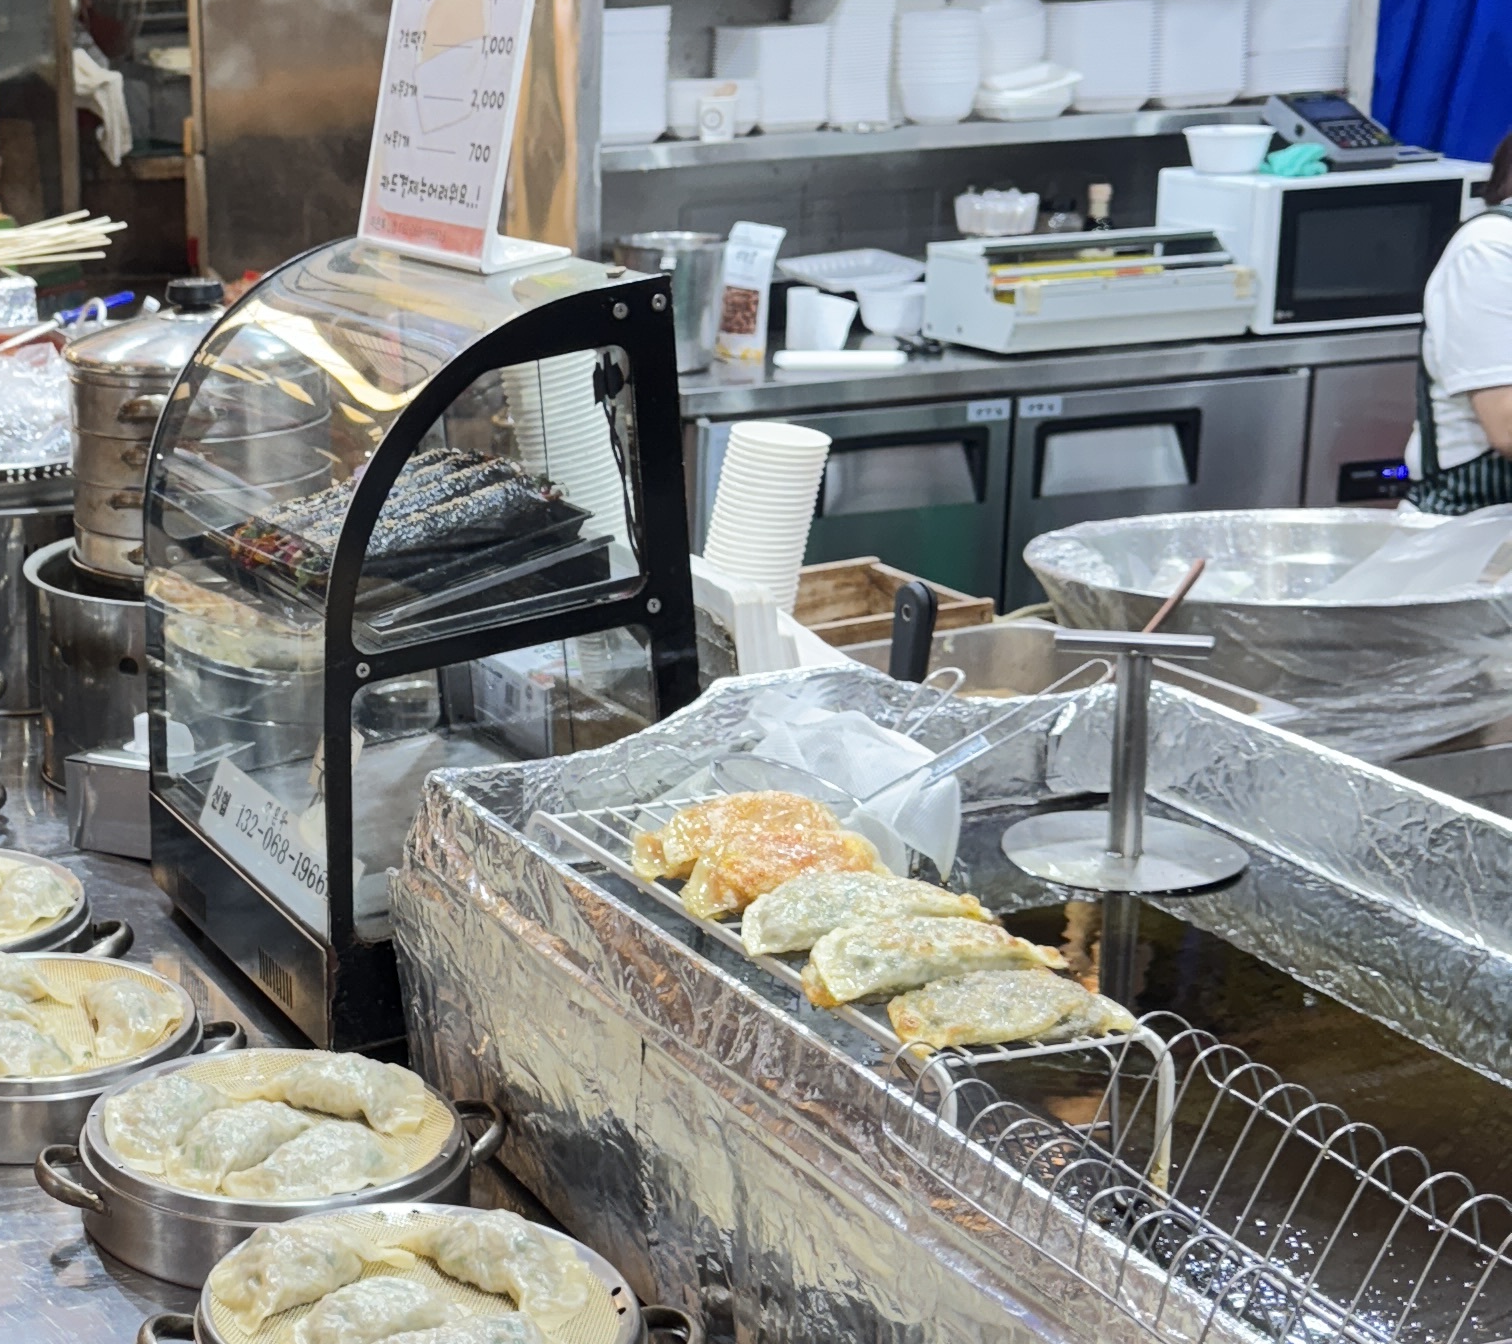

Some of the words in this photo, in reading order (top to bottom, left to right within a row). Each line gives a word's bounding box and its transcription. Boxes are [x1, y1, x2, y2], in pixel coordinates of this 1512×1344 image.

[481, 35, 514, 59] 1,000
[470, 89, 505, 112] 2,000
[468, 142, 492, 163] 700
[211, 784, 233, 818] 신협
[235, 803, 331, 898] 132-068-1966
